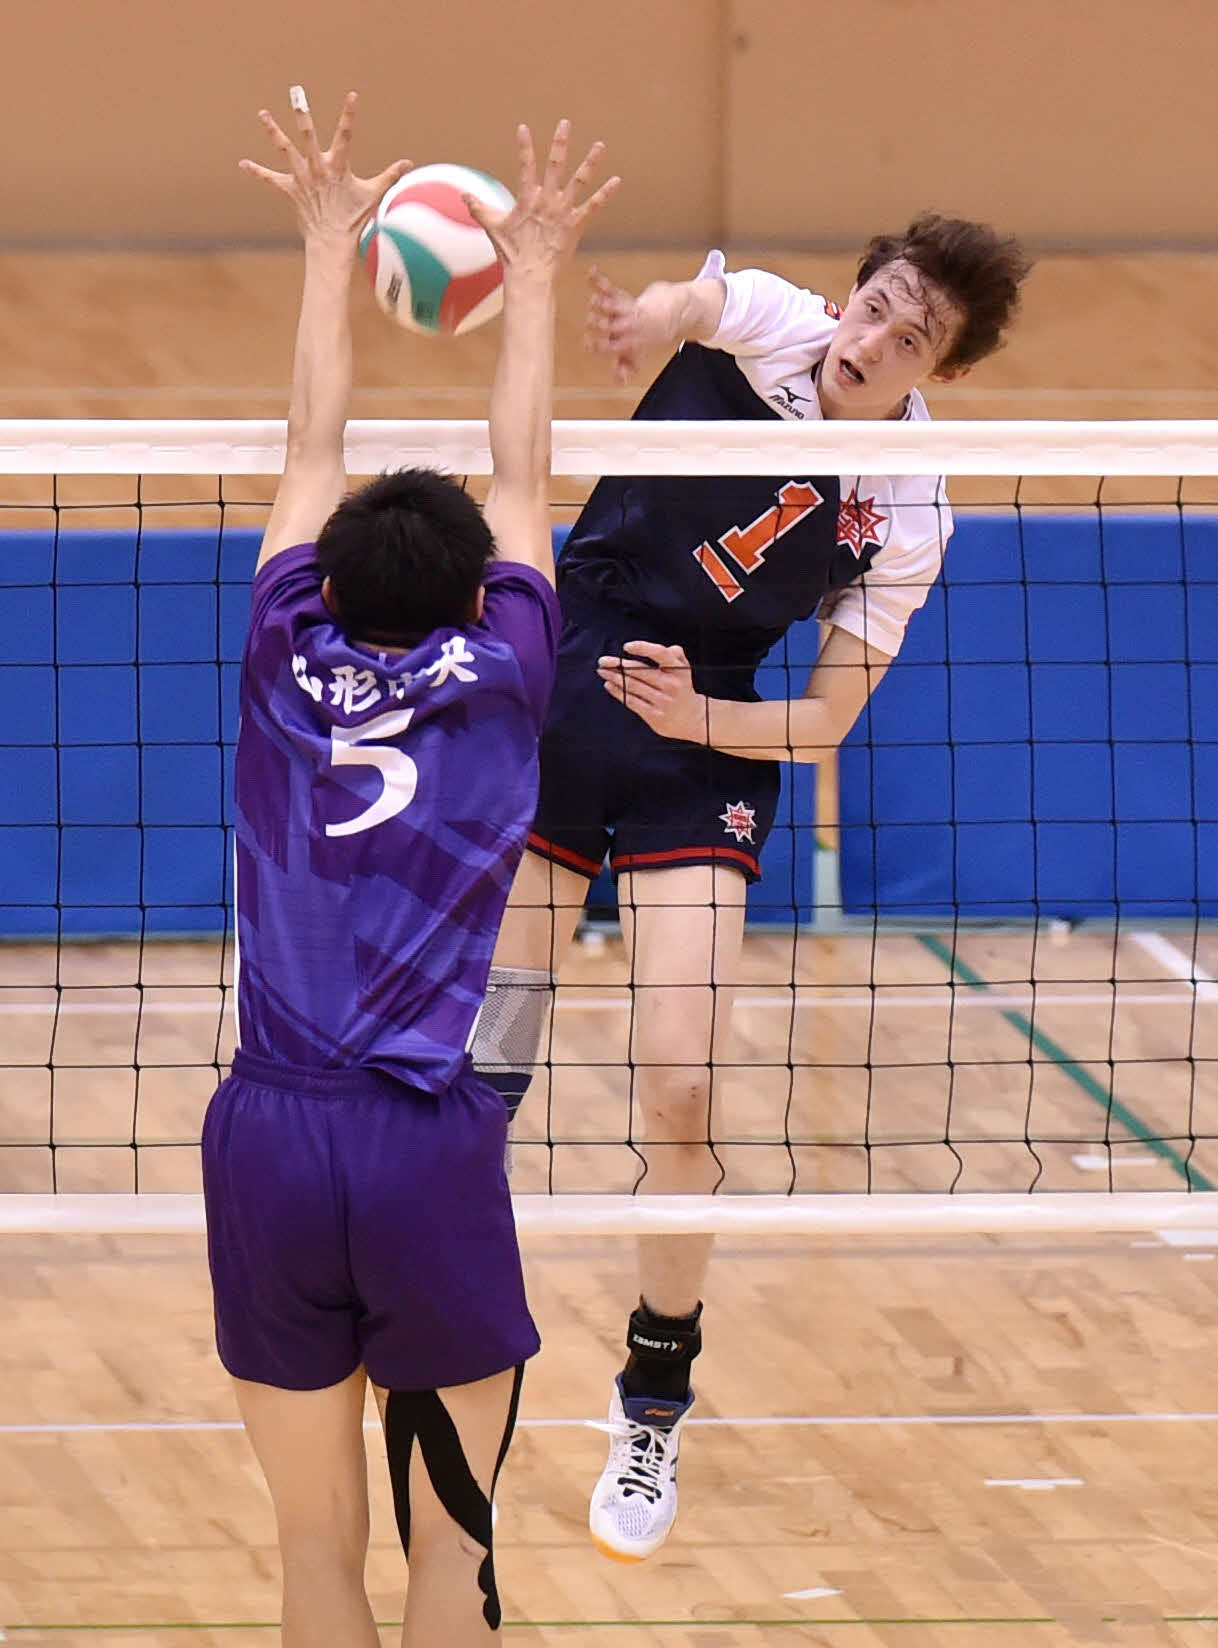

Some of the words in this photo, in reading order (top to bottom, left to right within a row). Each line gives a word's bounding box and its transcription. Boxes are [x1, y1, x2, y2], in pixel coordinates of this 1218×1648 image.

[768, 394, 805, 420] MIZUNO
[717, 479, 825, 576] 1
[325, 707, 418, 837] 5
